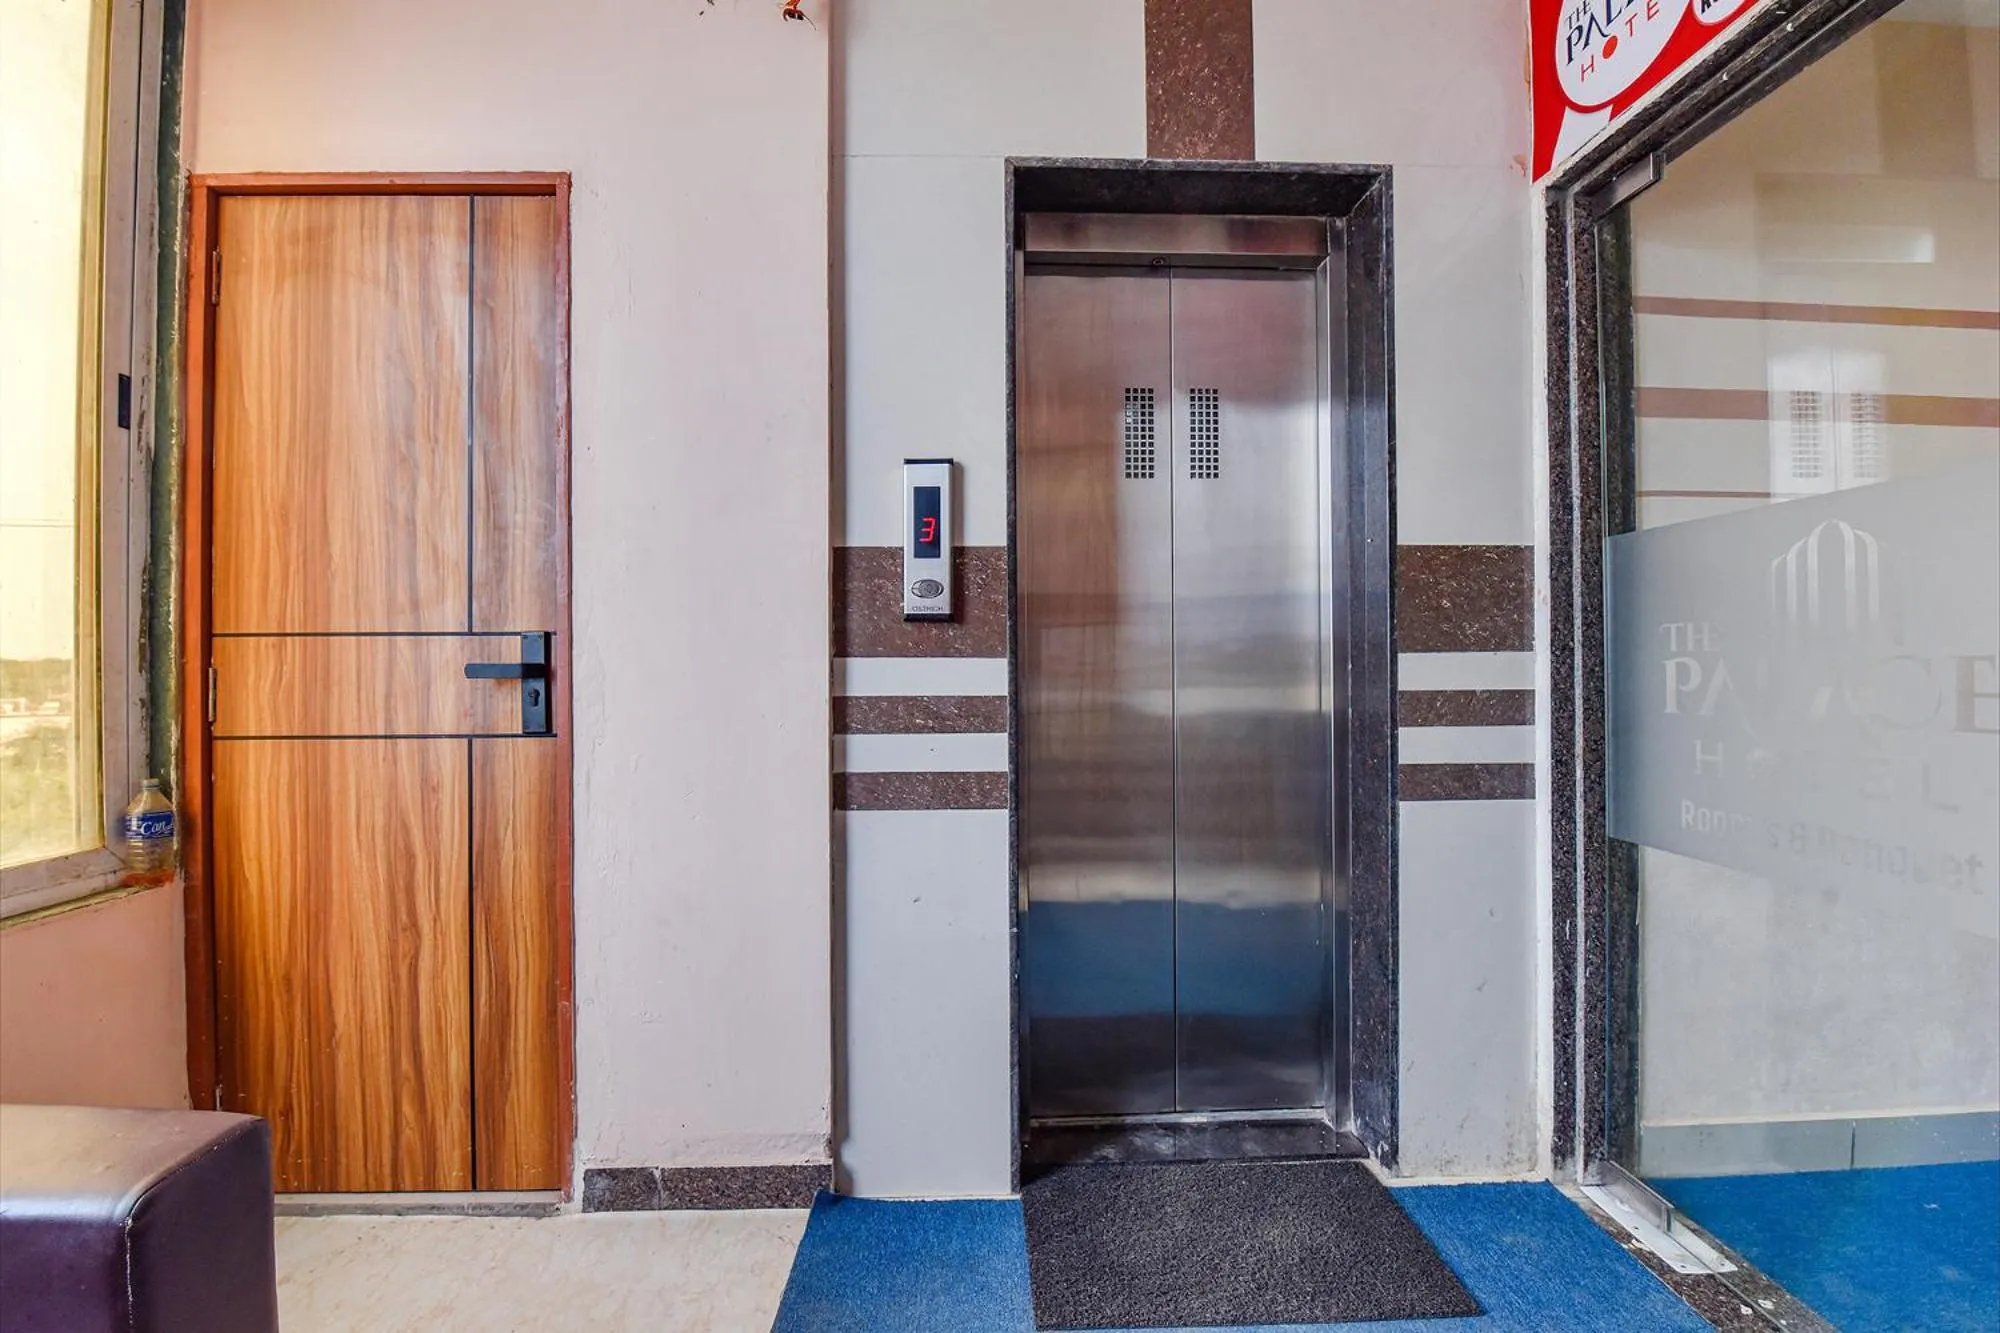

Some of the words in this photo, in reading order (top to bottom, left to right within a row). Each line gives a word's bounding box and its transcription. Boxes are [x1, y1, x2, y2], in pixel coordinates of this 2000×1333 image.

[1565, 0, 1591, 30] THE
[1566, 0, 1635, 66] PAL
[918, 517, 937, 542] 3
